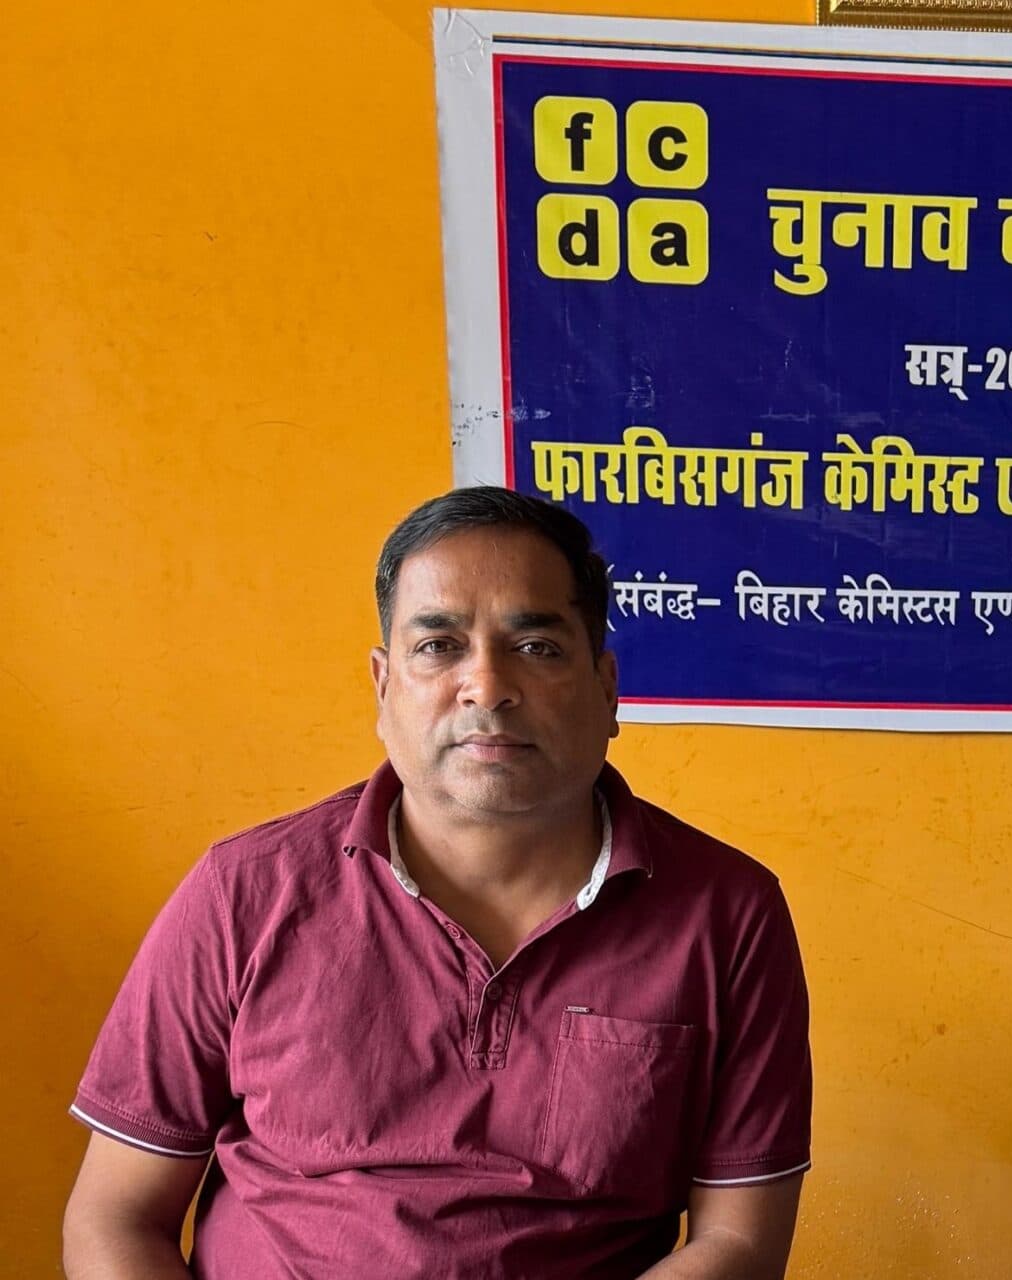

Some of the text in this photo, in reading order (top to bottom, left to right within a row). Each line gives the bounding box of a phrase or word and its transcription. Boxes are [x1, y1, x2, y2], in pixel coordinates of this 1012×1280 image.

[564, 112, 594, 172] f
[558, 208, 689, 267] d a
[766, 188, 978, 296] चुनाव
[530, 426, 809, 510] फारबिसगंज
[821, 433, 985, 514] केमिस्ट
[734, 570, 827, 626] बिहार
[835, 573, 961, 626] केमिस्टस
